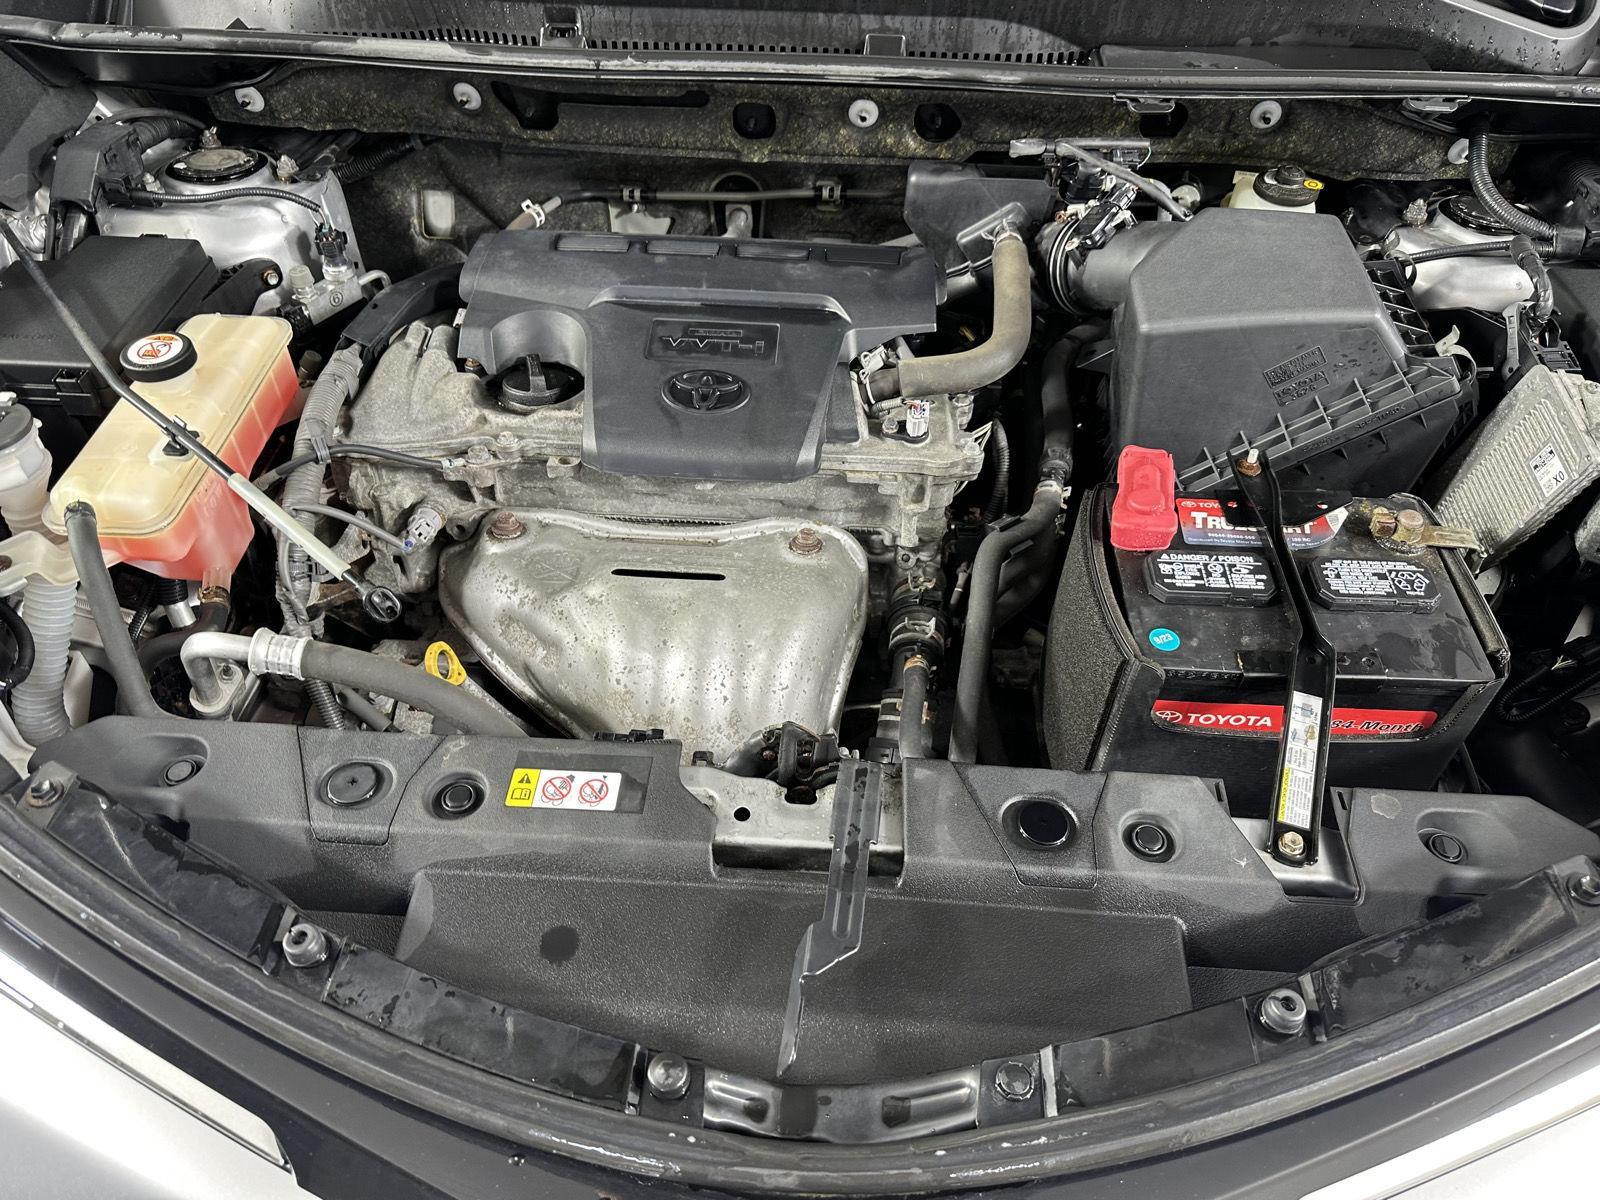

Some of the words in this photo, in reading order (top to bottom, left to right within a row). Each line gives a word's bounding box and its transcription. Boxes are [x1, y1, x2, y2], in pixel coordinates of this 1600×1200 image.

[1170, 553, 1209, 561] DANGER
[1218, 555, 1254, 563] POISON
[1188, 713, 1272, 727] TOYOTA
